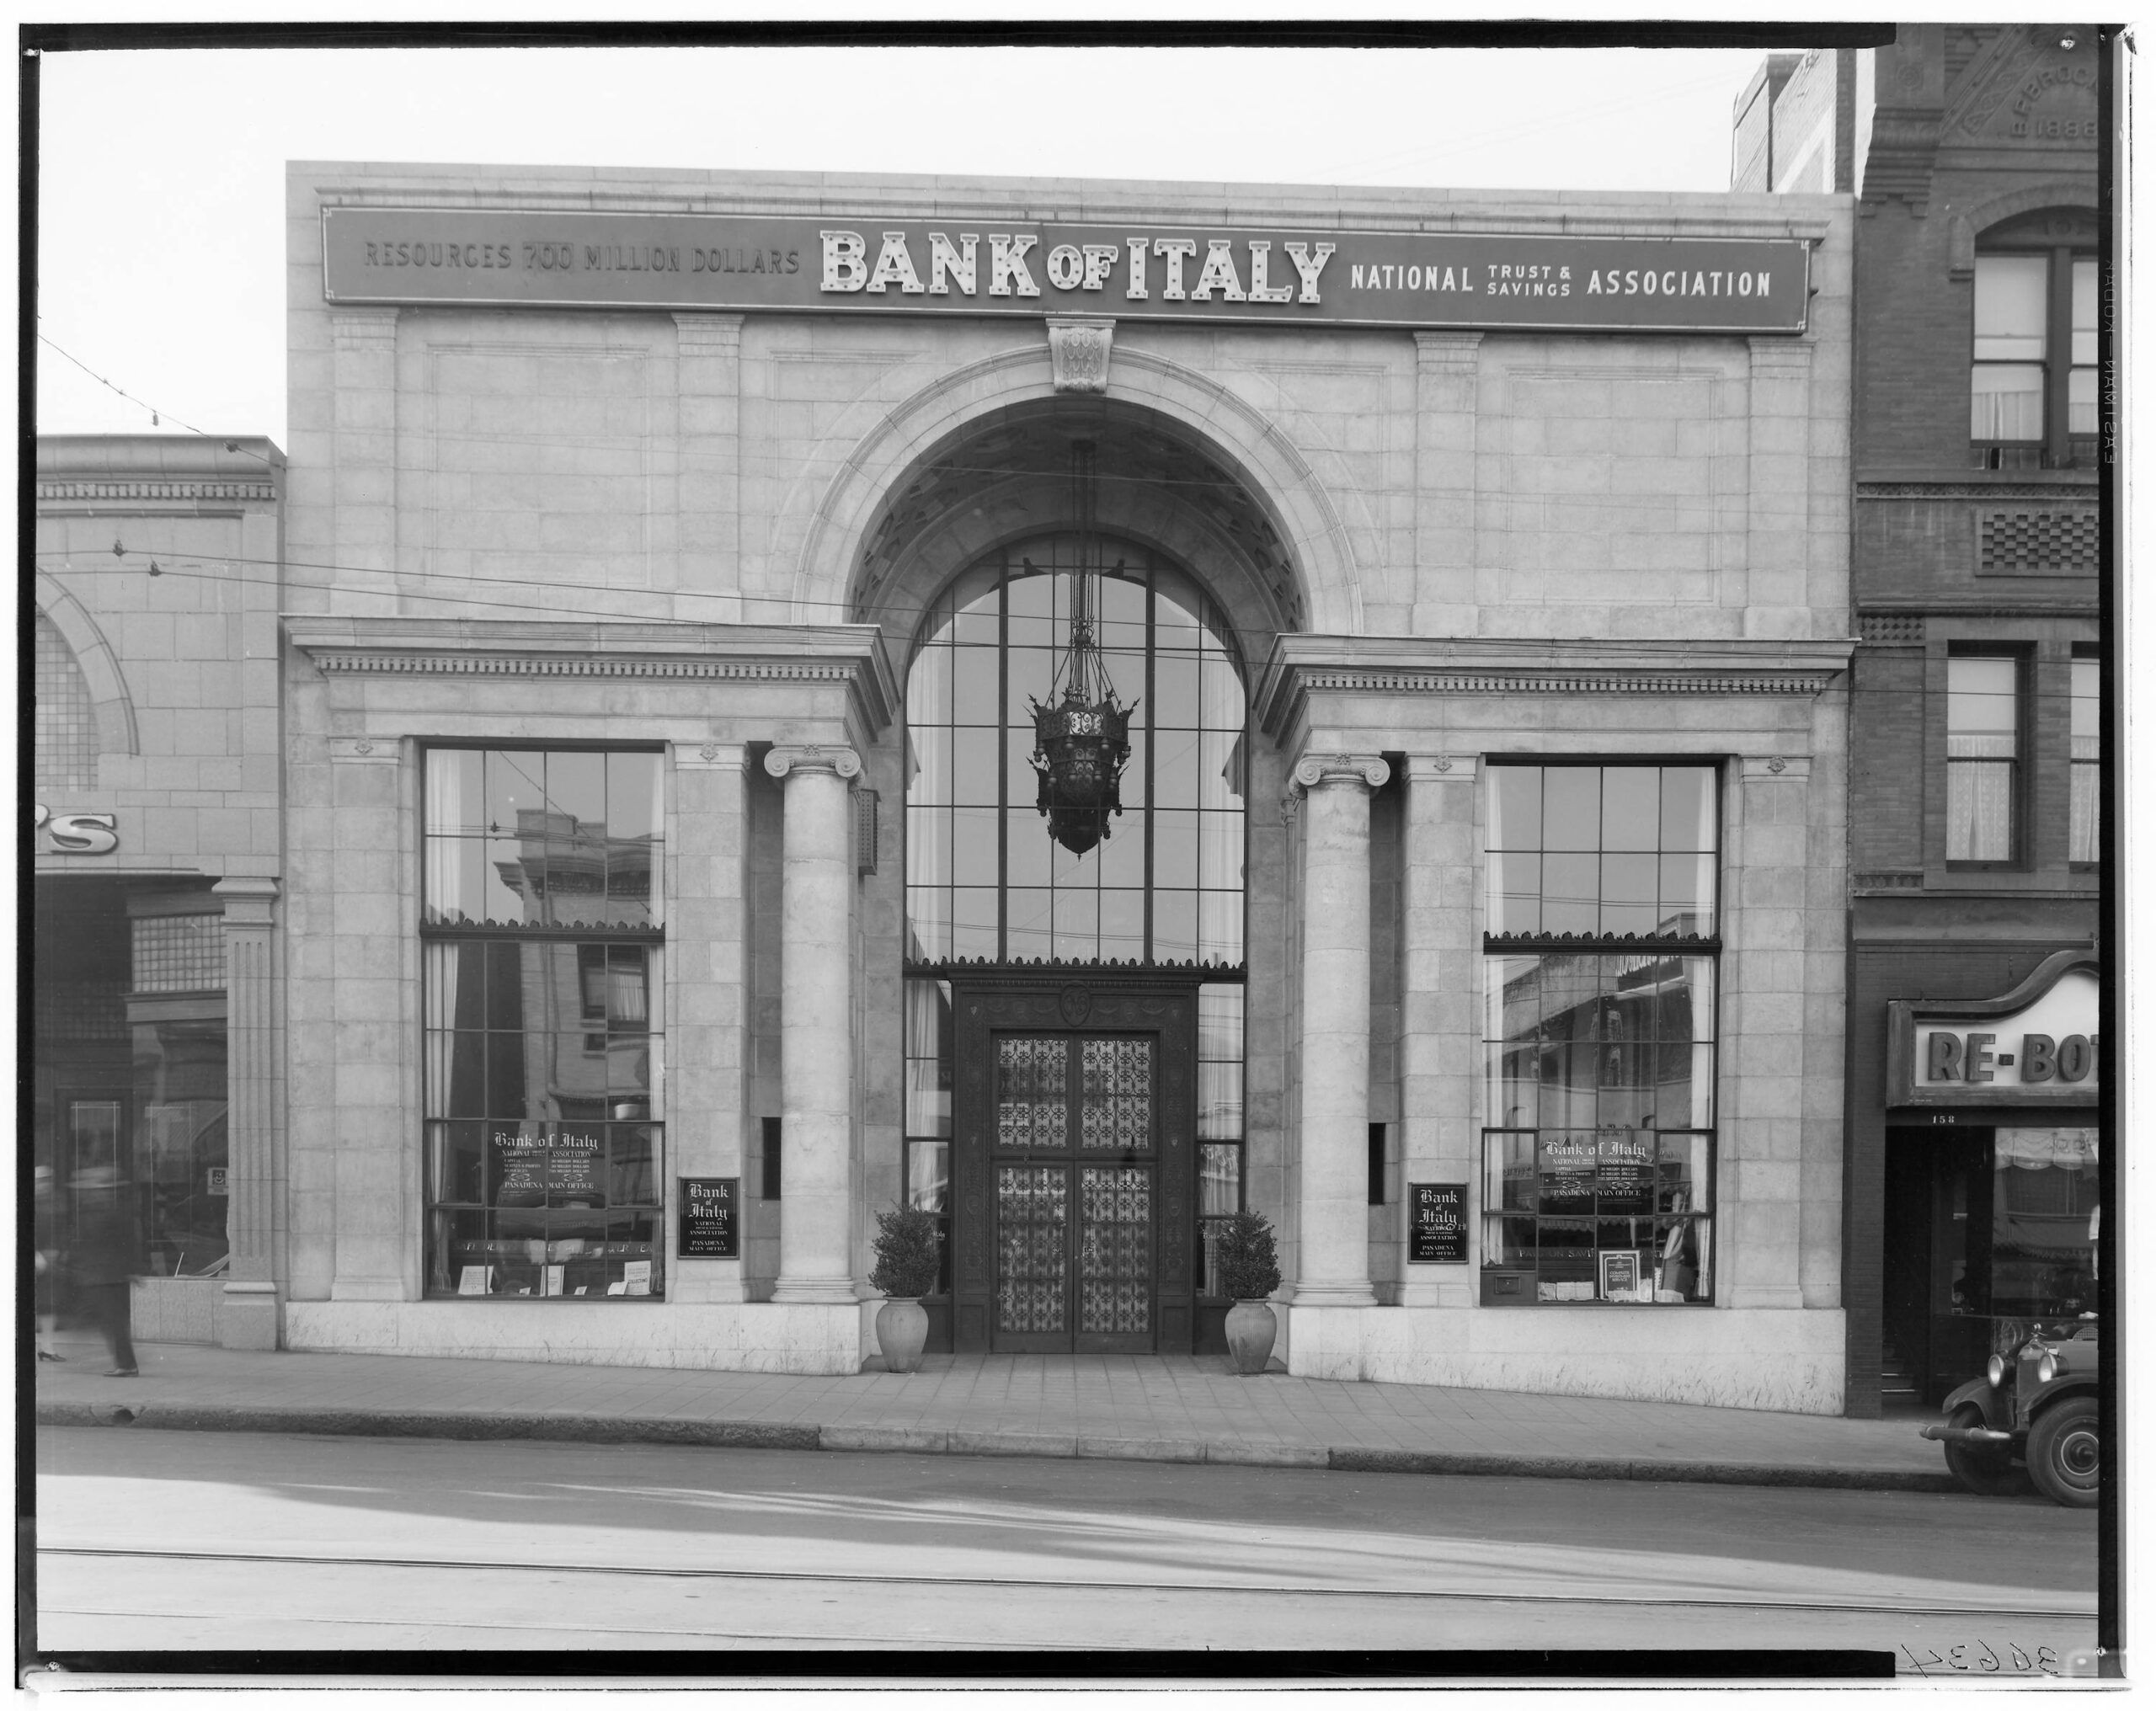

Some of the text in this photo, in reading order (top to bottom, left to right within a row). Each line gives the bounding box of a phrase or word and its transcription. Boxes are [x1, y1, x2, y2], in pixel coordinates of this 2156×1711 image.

[2022, 66, 2097, 102] BROC
[363, 241, 800, 275] RESOURCES 700 MILLION DOLLARS
[819, 230, 1337, 304] BANK OF ITALY
[1488, 264, 1572, 280] TRUST &
[1351, 264, 1474, 292] NATIONAL
[1587, 269, 1771, 297] ASSOCIATION
[1487, 282, 1572, 297] SAVINGS
[1928, 1032, 2099, 1082] RE-BO
[1933, 1116, 1955, 1124] 158
[494, 1133, 599, 1150] Bank of Italy
[1546, 1141, 1646, 1158] Bank of Italy
[689, 1183, 728, 1197] Bank
[1420, 1189, 1458, 1203] Bank
[689, 1203, 728, 1220] Italy
[1419, 1209, 1457, 1226] Italy
